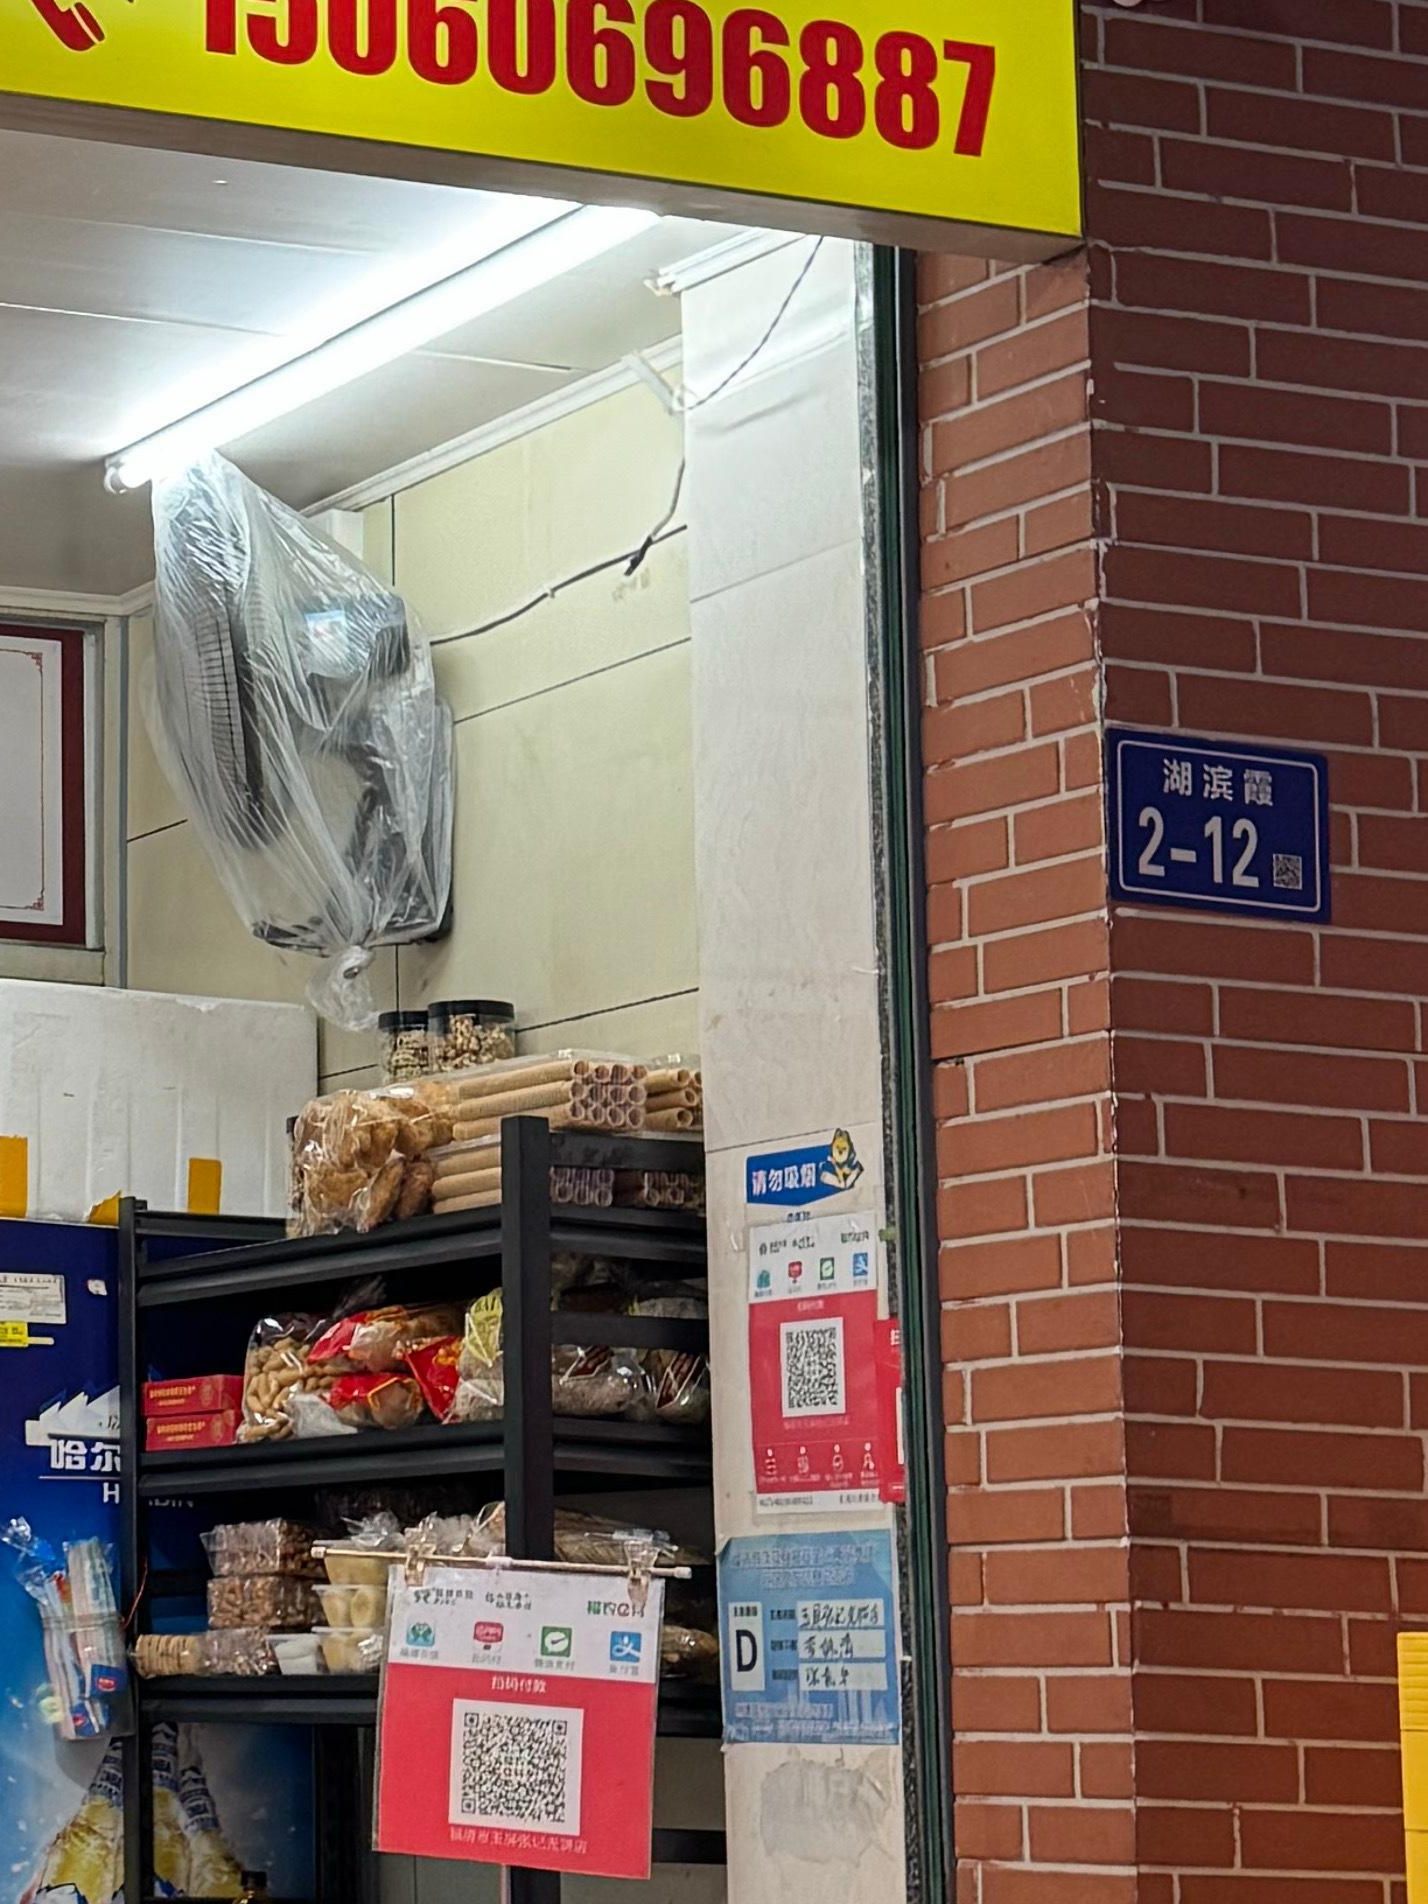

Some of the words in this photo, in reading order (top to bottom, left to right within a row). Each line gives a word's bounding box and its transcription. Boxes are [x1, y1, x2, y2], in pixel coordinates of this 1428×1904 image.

[1162, 758, 1274, 807] 湖滨霞
[1138, 806, 1260, 888] 2-12
[752, 1162, 817, 1197] 请勿吸烟
[735, 1628, 759, 1673] D
